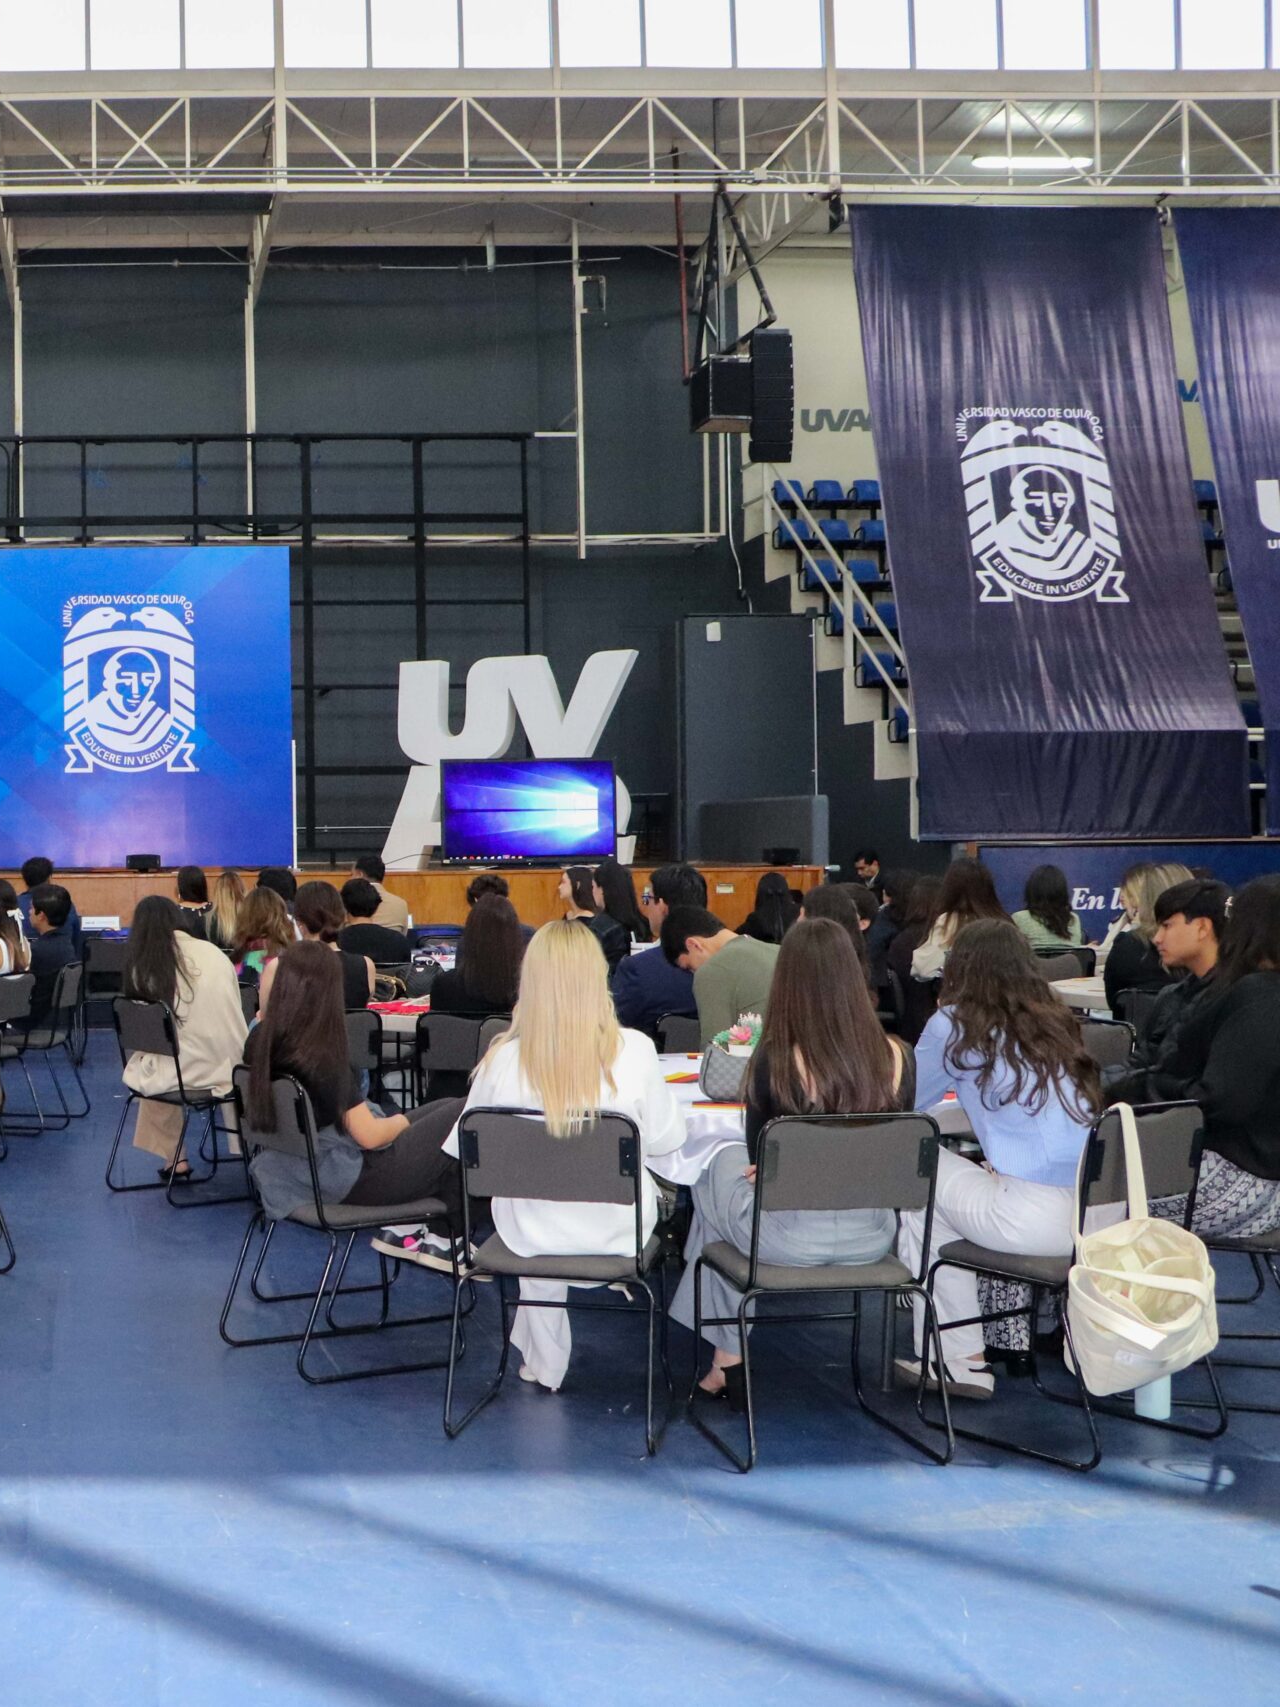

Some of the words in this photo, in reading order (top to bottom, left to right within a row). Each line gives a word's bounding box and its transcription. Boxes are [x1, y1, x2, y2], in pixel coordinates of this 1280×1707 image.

[801, 408, 873, 432] UVA
[955, 407, 1009, 442] UNIVERSIDAD
[1010, 407, 1046, 418] VASCO
[1047, 407, 1062, 418] DE
[1063, 408, 1104, 442] QUIROGA
[992, 556, 1044, 593] EDUCERE
[1046, 582, 1060, 594] IN
[1060, 557, 1106, 594] VERITATE
[62, 594, 112, 627] UNIVERSIDAD
[112, 594, 146, 605] VASCO
[146, 594, 160, 605] DE
[160, 594, 195, 625] QUIROGA
[81, 732, 122, 765] EDUCERE
[123, 754, 136, 766] IN
[135, 731, 179, 765] VERITATE
[1070, 887, 1106, 910] En
